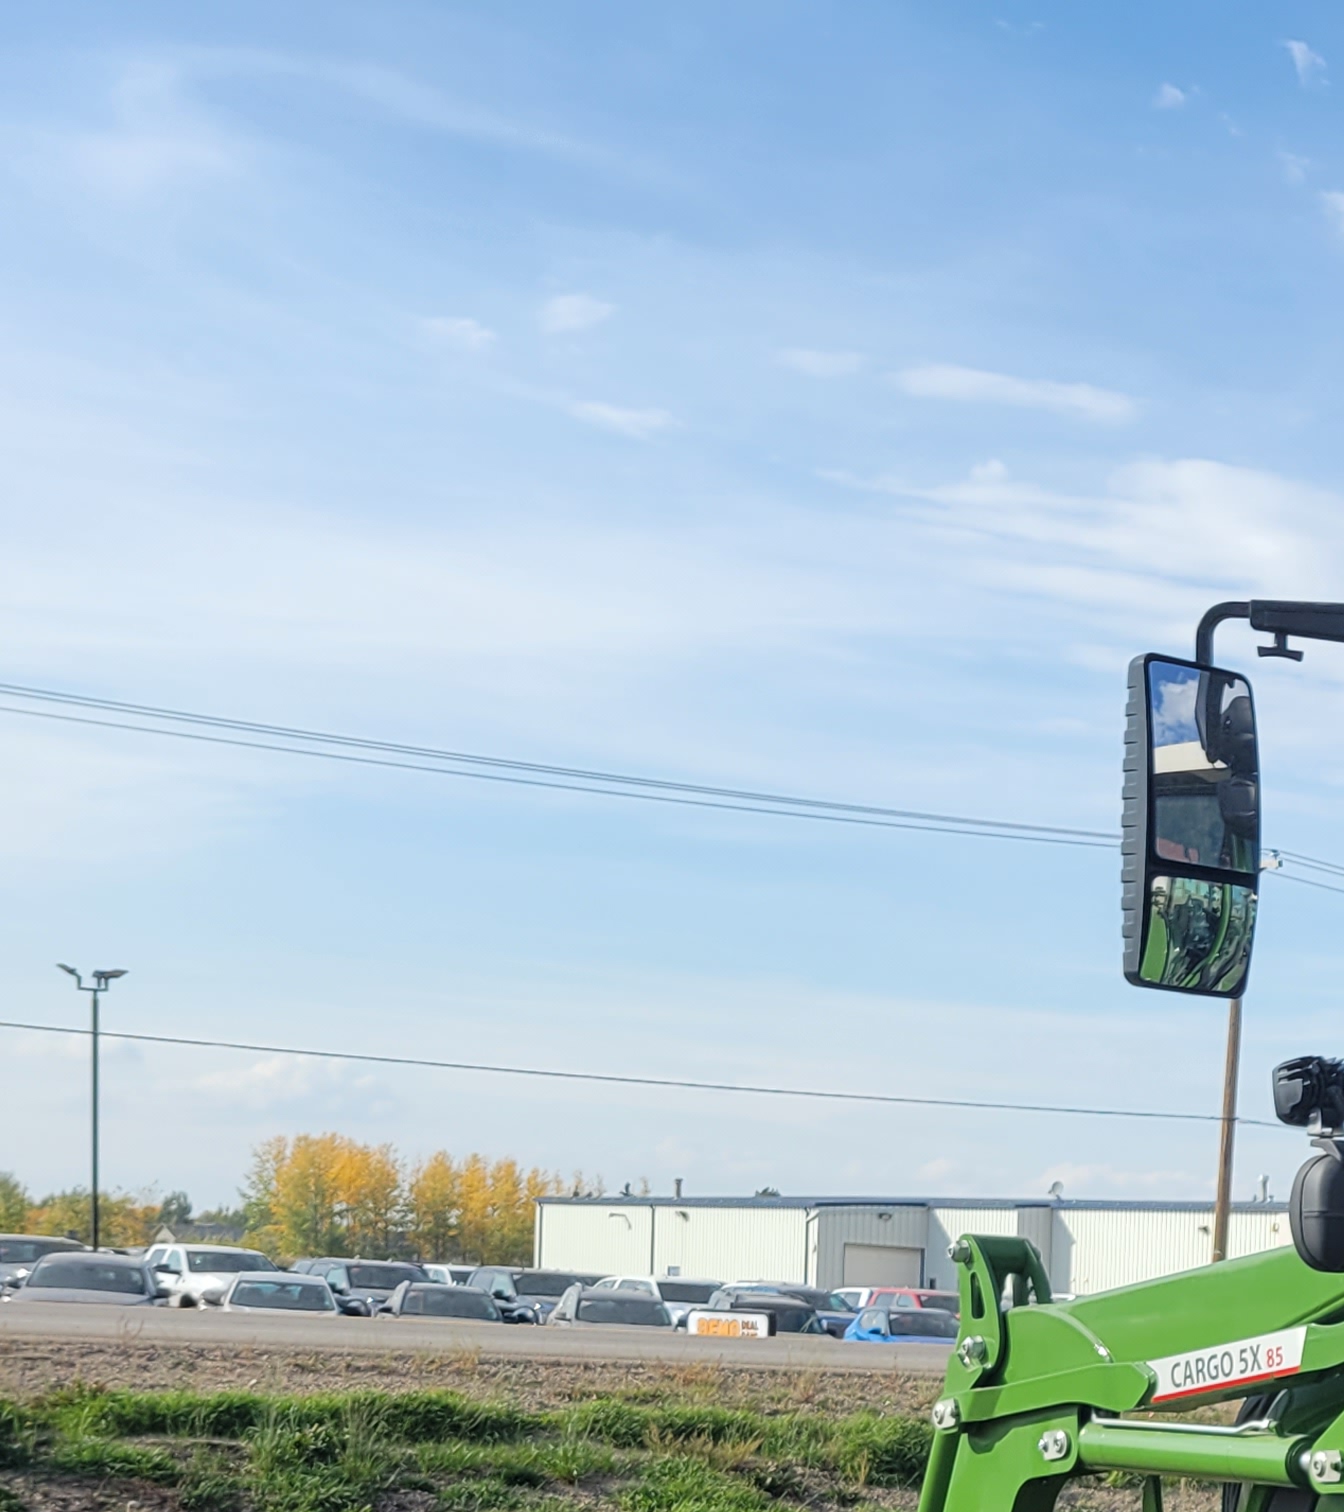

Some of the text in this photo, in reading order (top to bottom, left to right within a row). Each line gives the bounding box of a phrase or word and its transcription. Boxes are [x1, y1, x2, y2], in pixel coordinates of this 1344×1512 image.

[1170, 1343, 1284, 1389] CARGO 5X 85
